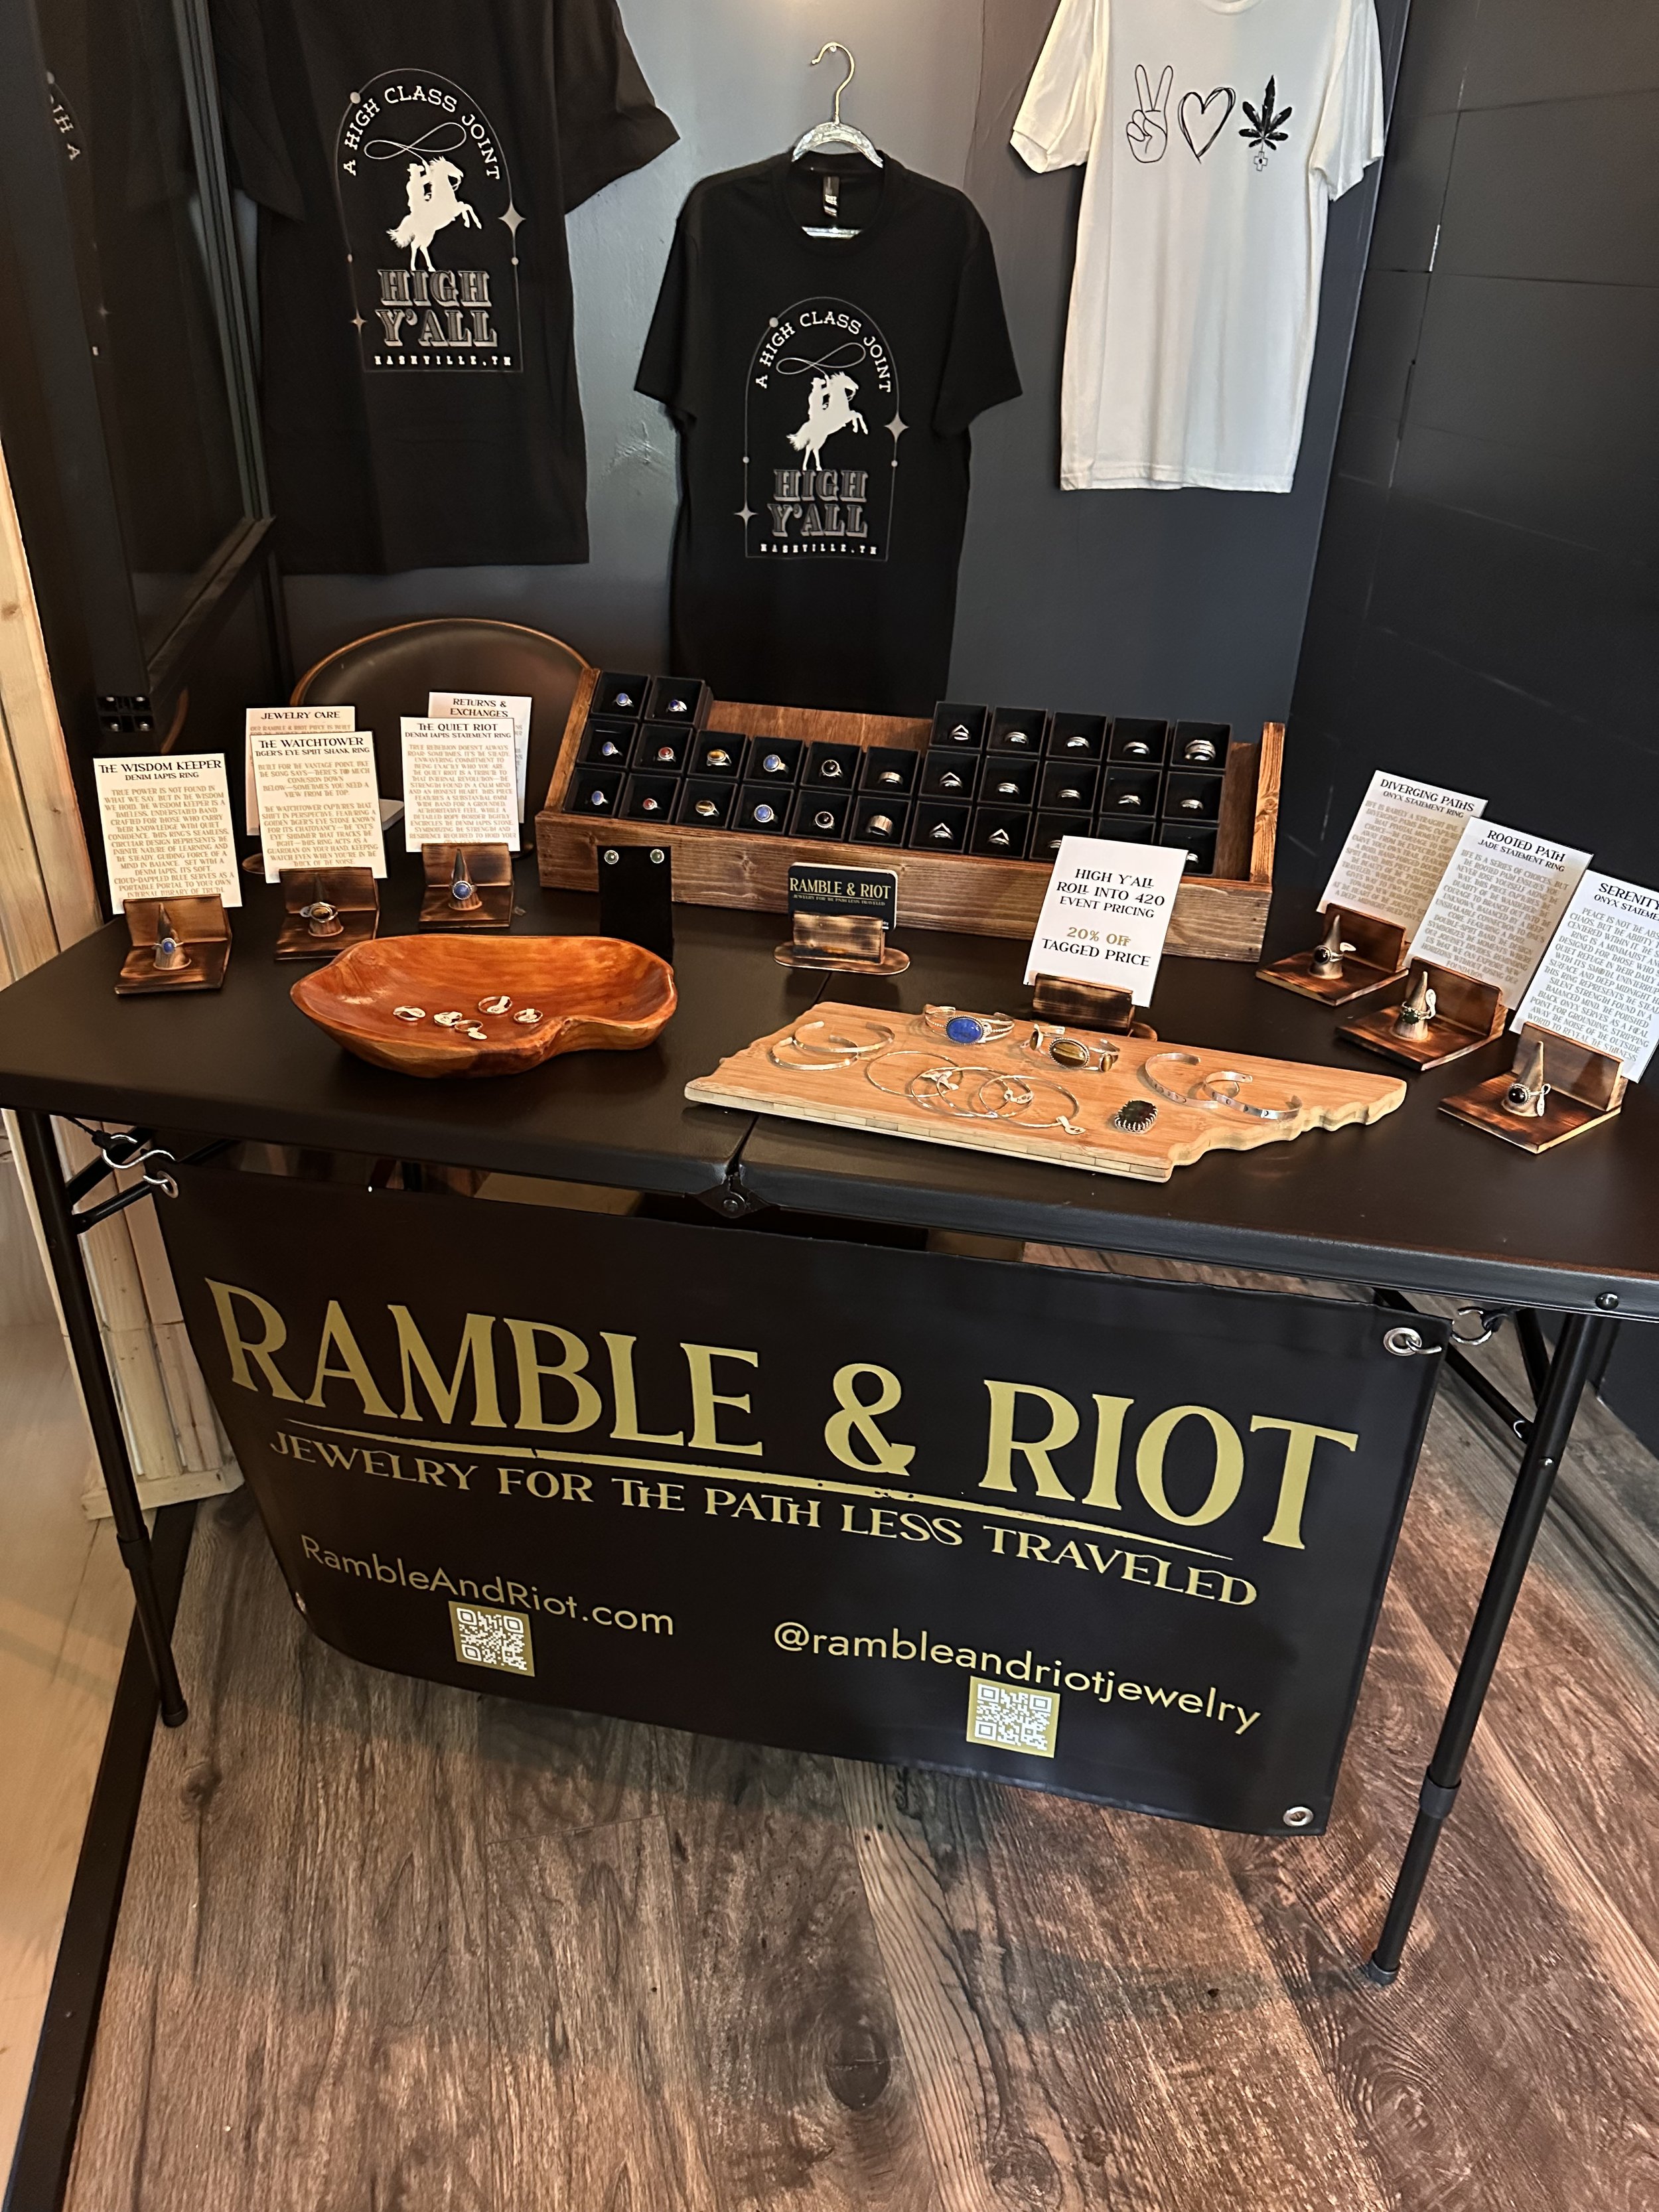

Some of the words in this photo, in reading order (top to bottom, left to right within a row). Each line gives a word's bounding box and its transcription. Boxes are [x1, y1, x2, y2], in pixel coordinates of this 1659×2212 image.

[385, 86, 457, 112] CLASS
[344, 98, 380, 150] HIGH
[462, 114, 500, 179] JOINT
[344, 160, 356, 175] A
[377, 269, 492, 307] HIGH
[375, 309, 498, 347] Y'ALL
[800, 311, 861, 334] CLASS
[760, 323, 795, 366] HIGH
[864, 336, 891, 392] JOINT
[756, 376, 767, 388] A
[774, 469, 869, 502] HIGH
[767, 503, 868, 538] Y'ALL
[451, 708, 508, 717] EXCHANGES
[453, 698, 496, 707] RETURNS
[280, 737, 364, 747] WATCHTOWER
[98, 765, 117, 773] THE
[121, 762, 173, 772] WISDOM
[177, 760, 222, 770] KEEPER
[1380, 779, 1439, 802] DIVERGING
[1441, 796, 1475, 812] PATHS
[1383, 790, 1404, 802] ONYX
[1404, 797, 1445, 812] STATEMENT
[1445, 808, 1464, 818] RING
[1478, 840, 1499, 850] JADE
[1500, 846, 1545, 865] STATEMENT
[1545, 861, 1565, 872] RING
[1487, 830, 1532, 851] ROOTED
[1535, 846, 1565, 862] PATH
[790, 878, 842, 895] RAMBLE
[847, 883, 855, 896] &
[860, 883, 891, 899] RIOT
[1056, 881, 1088, 895] ROLL
[1094, 887, 1129, 901] INTO
[1135, 893, 1165, 906] 420
[1075, 869, 1113, 883] HIGH
[1119, 874, 1154, 889] Y'ALL
[1060, 896, 1100, 909] EVENT
[1104, 903, 1154, 918] PRICING
[1594, 894, 1619, 908] ONYX
[1598, 883, 1659, 910] SERENITY
[1066, 927, 1100, 942] 20%
[1106, 934, 1131, 946] OFF
[1582, 907, 1606, 921] PEACE
[1606, 915, 1615, 924] IS
[1615, 919, 1632, 929] NOT
[1632, 924, 1644, 934] THE
[1043, 938, 1100, 957] TAGGED
[1105, 950, 1151, 966] PRICE
[1559, 935, 1594, 952] DESIGNED
[1594, 948, 1610, 959] FOR
[1611, 954, 1634, 967] THOSE
[1636, 962, 1655, 974] WHO
[1549, 977, 1574, 990] SILENT
[1574, 986, 1611, 1005] STRENGTH
[1611, 1000, 1636, 1014] FOUND
[1531, 1006, 1551, 1018] AWAY
[1552, 1013, 1563, 1023] THE
[1563, 1018, 1585, 1031] NOISE
[1597, 1031, 1609, 1041] THE
[1609, 1037, 1641, 1054] OUTSIDE
[1538, 990, 1559, 1003] BLACK
[1560, 999, 1581, 1011] ONYX
[1581, 1007, 1609, 1022] SERVES
[1628, 1025, 1648, 1039] FOCAL
[204, 1278, 763, 1456] RAMBLE
[824, 1363, 916, 1476] &
[977, 1379, 1359, 1550] RIOT
[269, 1430, 479, 1491] JEWELRY
[496, 1469, 595, 1503] FOR
[611, 1478, 685, 1512] THE
[705, 1487, 822, 1528] PATH
[841, 1504, 963, 1546] LESS
[983, 1524, 1258, 1606] TRAVELED
[301, 1534, 674, 1635] RambleAndRiot.com
[774, 1621, 1262, 1735] @rambleandriotjewelry
